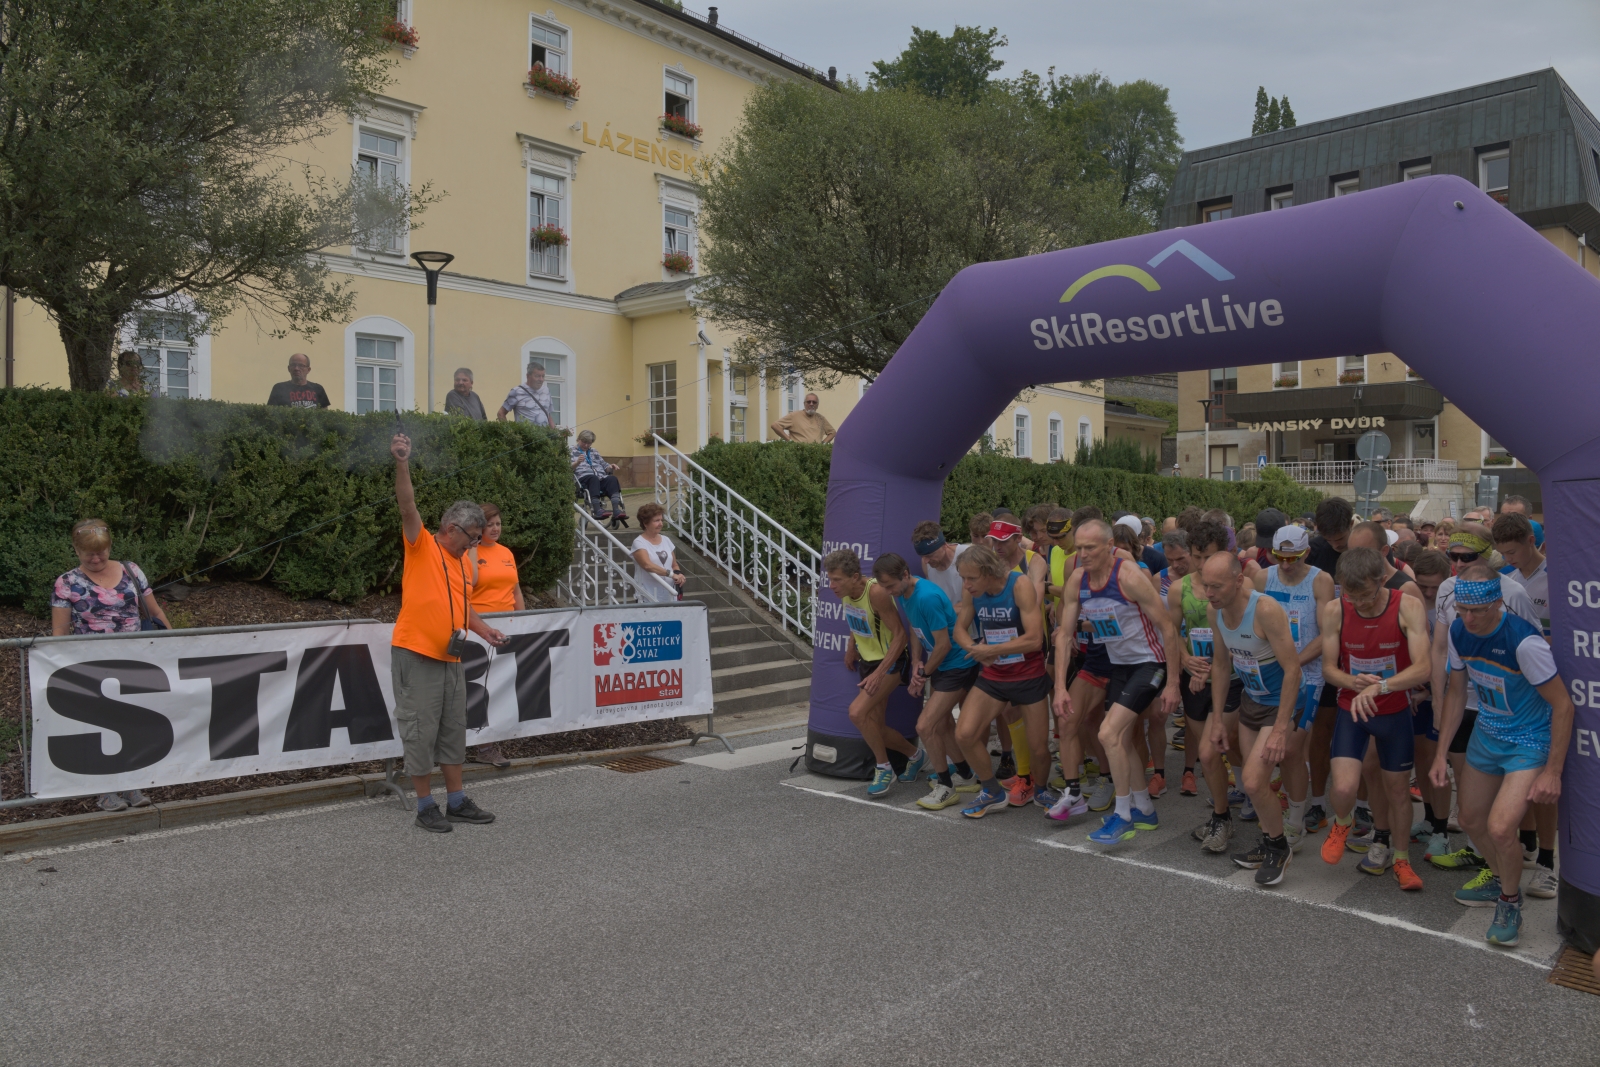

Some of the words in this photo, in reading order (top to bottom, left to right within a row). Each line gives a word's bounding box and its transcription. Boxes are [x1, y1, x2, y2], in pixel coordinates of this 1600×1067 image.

[582, 121, 712, 180] LÁZEŇSKÝ
[1030, 294, 1285, 350] SkiResortLive
[1248, 418, 1323, 433] JANSKÝ
[1331, 416, 1386, 430] DVŮR
[977, 606, 1013, 618] ALISY
[636, 624, 663, 636] ČESKÝ
[849, 615, 869, 634] 104
[1092, 620, 1117, 638] 115
[636, 634, 680, 648] ATLETICKÝ
[637, 649, 659, 659] SVAZ
[595, 668, 682, 694] MARATON
[659, 688, 680, 697] stav
[1477, 684, 1496, 708] 61
[641, 701, 664, 711] jednota
